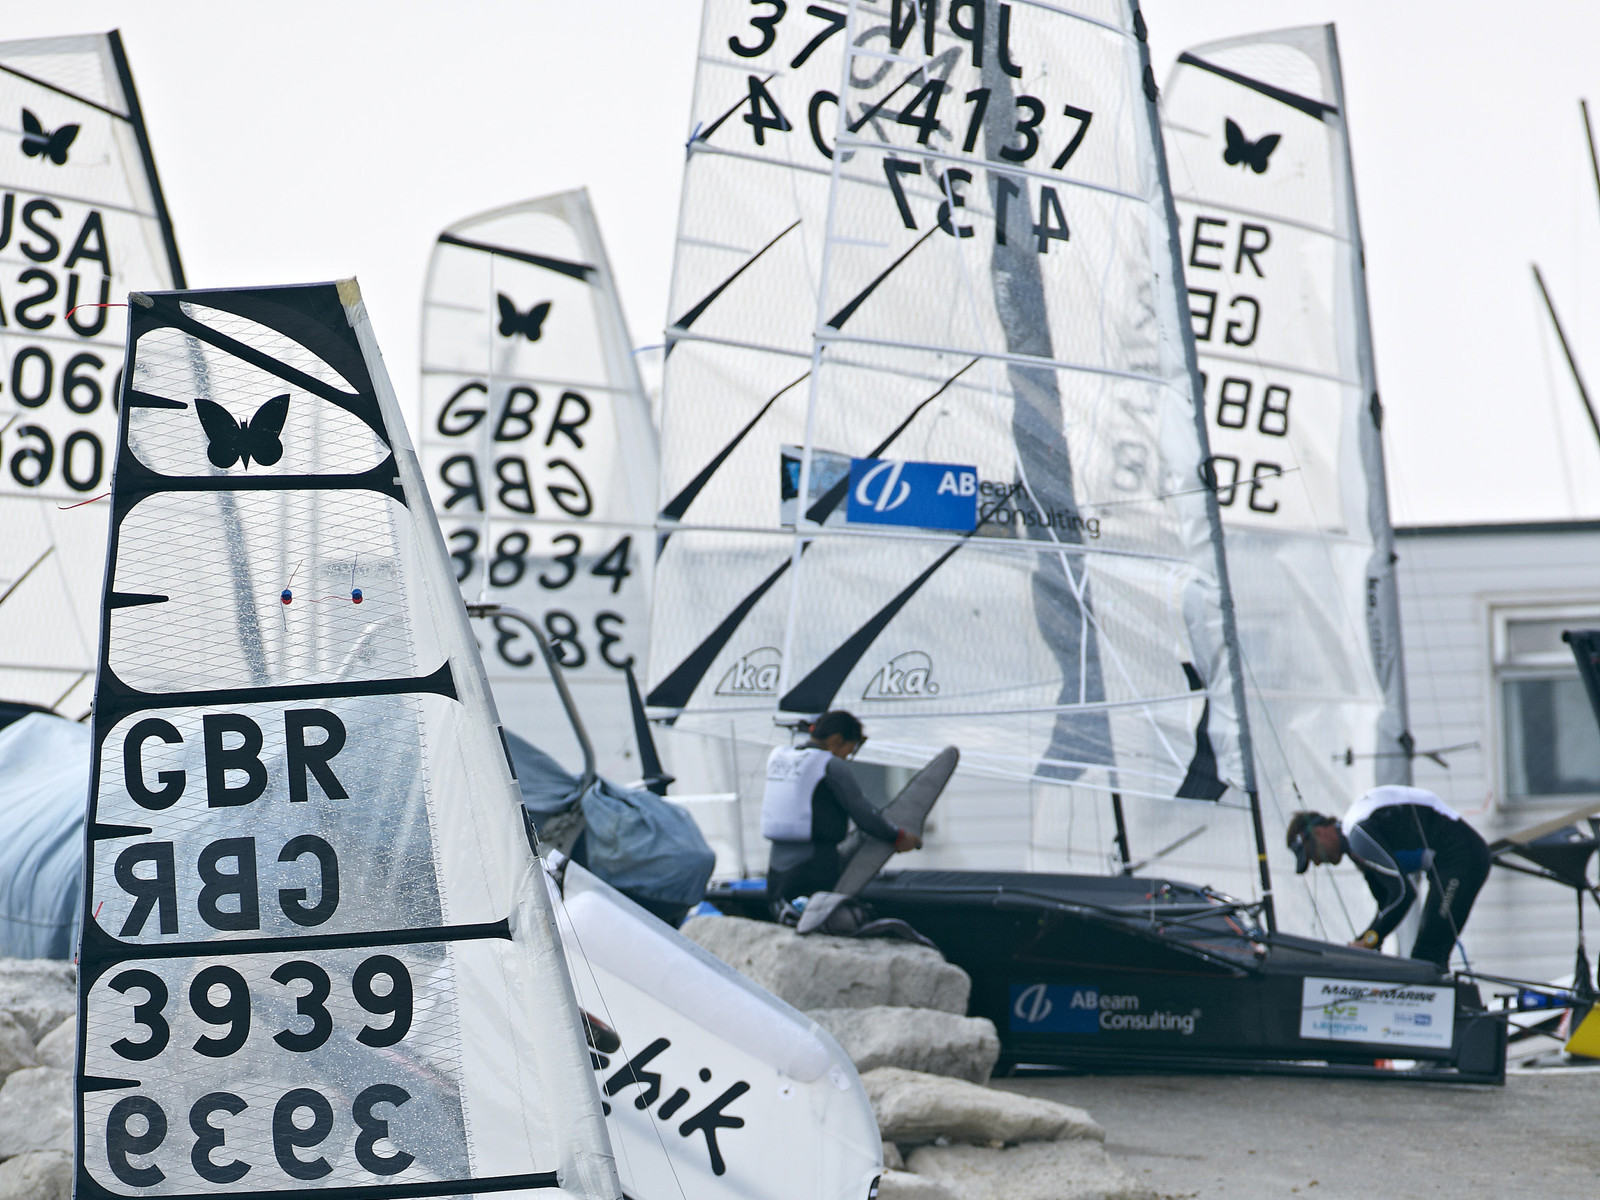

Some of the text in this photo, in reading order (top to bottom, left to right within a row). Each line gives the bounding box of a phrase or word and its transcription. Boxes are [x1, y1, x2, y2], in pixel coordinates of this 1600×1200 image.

[896, 79, 1093, 170] 4137
[438, 382, 591, 449] GBR
[936, 470, 1030, 503] ABeam
[979, 500, 1101, 541] Consulting
[450, 527, 633, 593] 3834
[123, 708, 350, 810] GBR
[107, 954, 414, 1061] 3939
[1070, 990, 1139, 1010] ABeam
